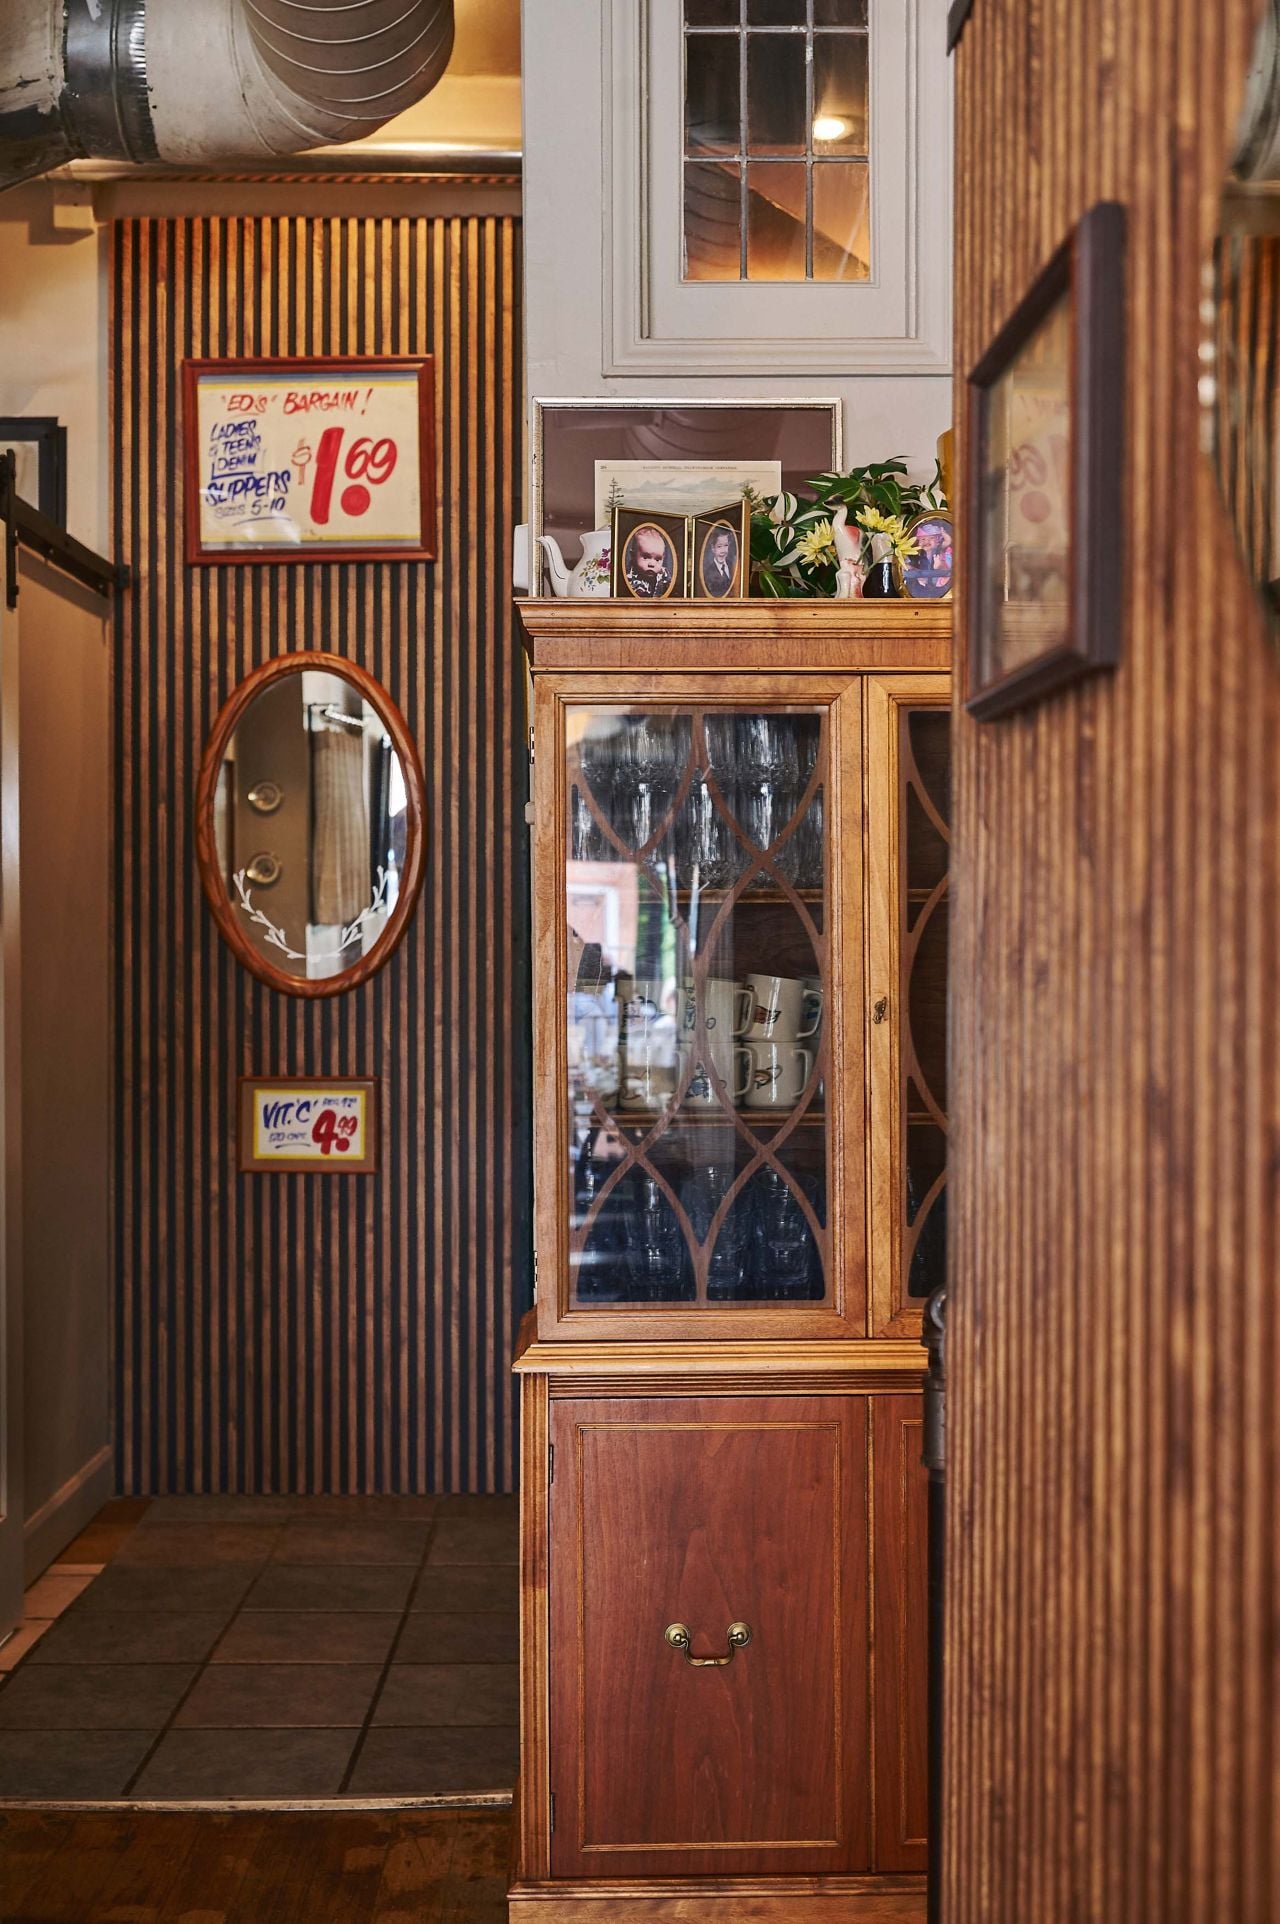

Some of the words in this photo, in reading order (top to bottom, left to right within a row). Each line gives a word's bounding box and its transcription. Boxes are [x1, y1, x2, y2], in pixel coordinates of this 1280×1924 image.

[210, 419, 257, 442] LADIES
[222, 435, 261, 456] TEENS
[205, 470, 291, 506] SLIPPERS
[249, 497, 286, 516] 5-10
